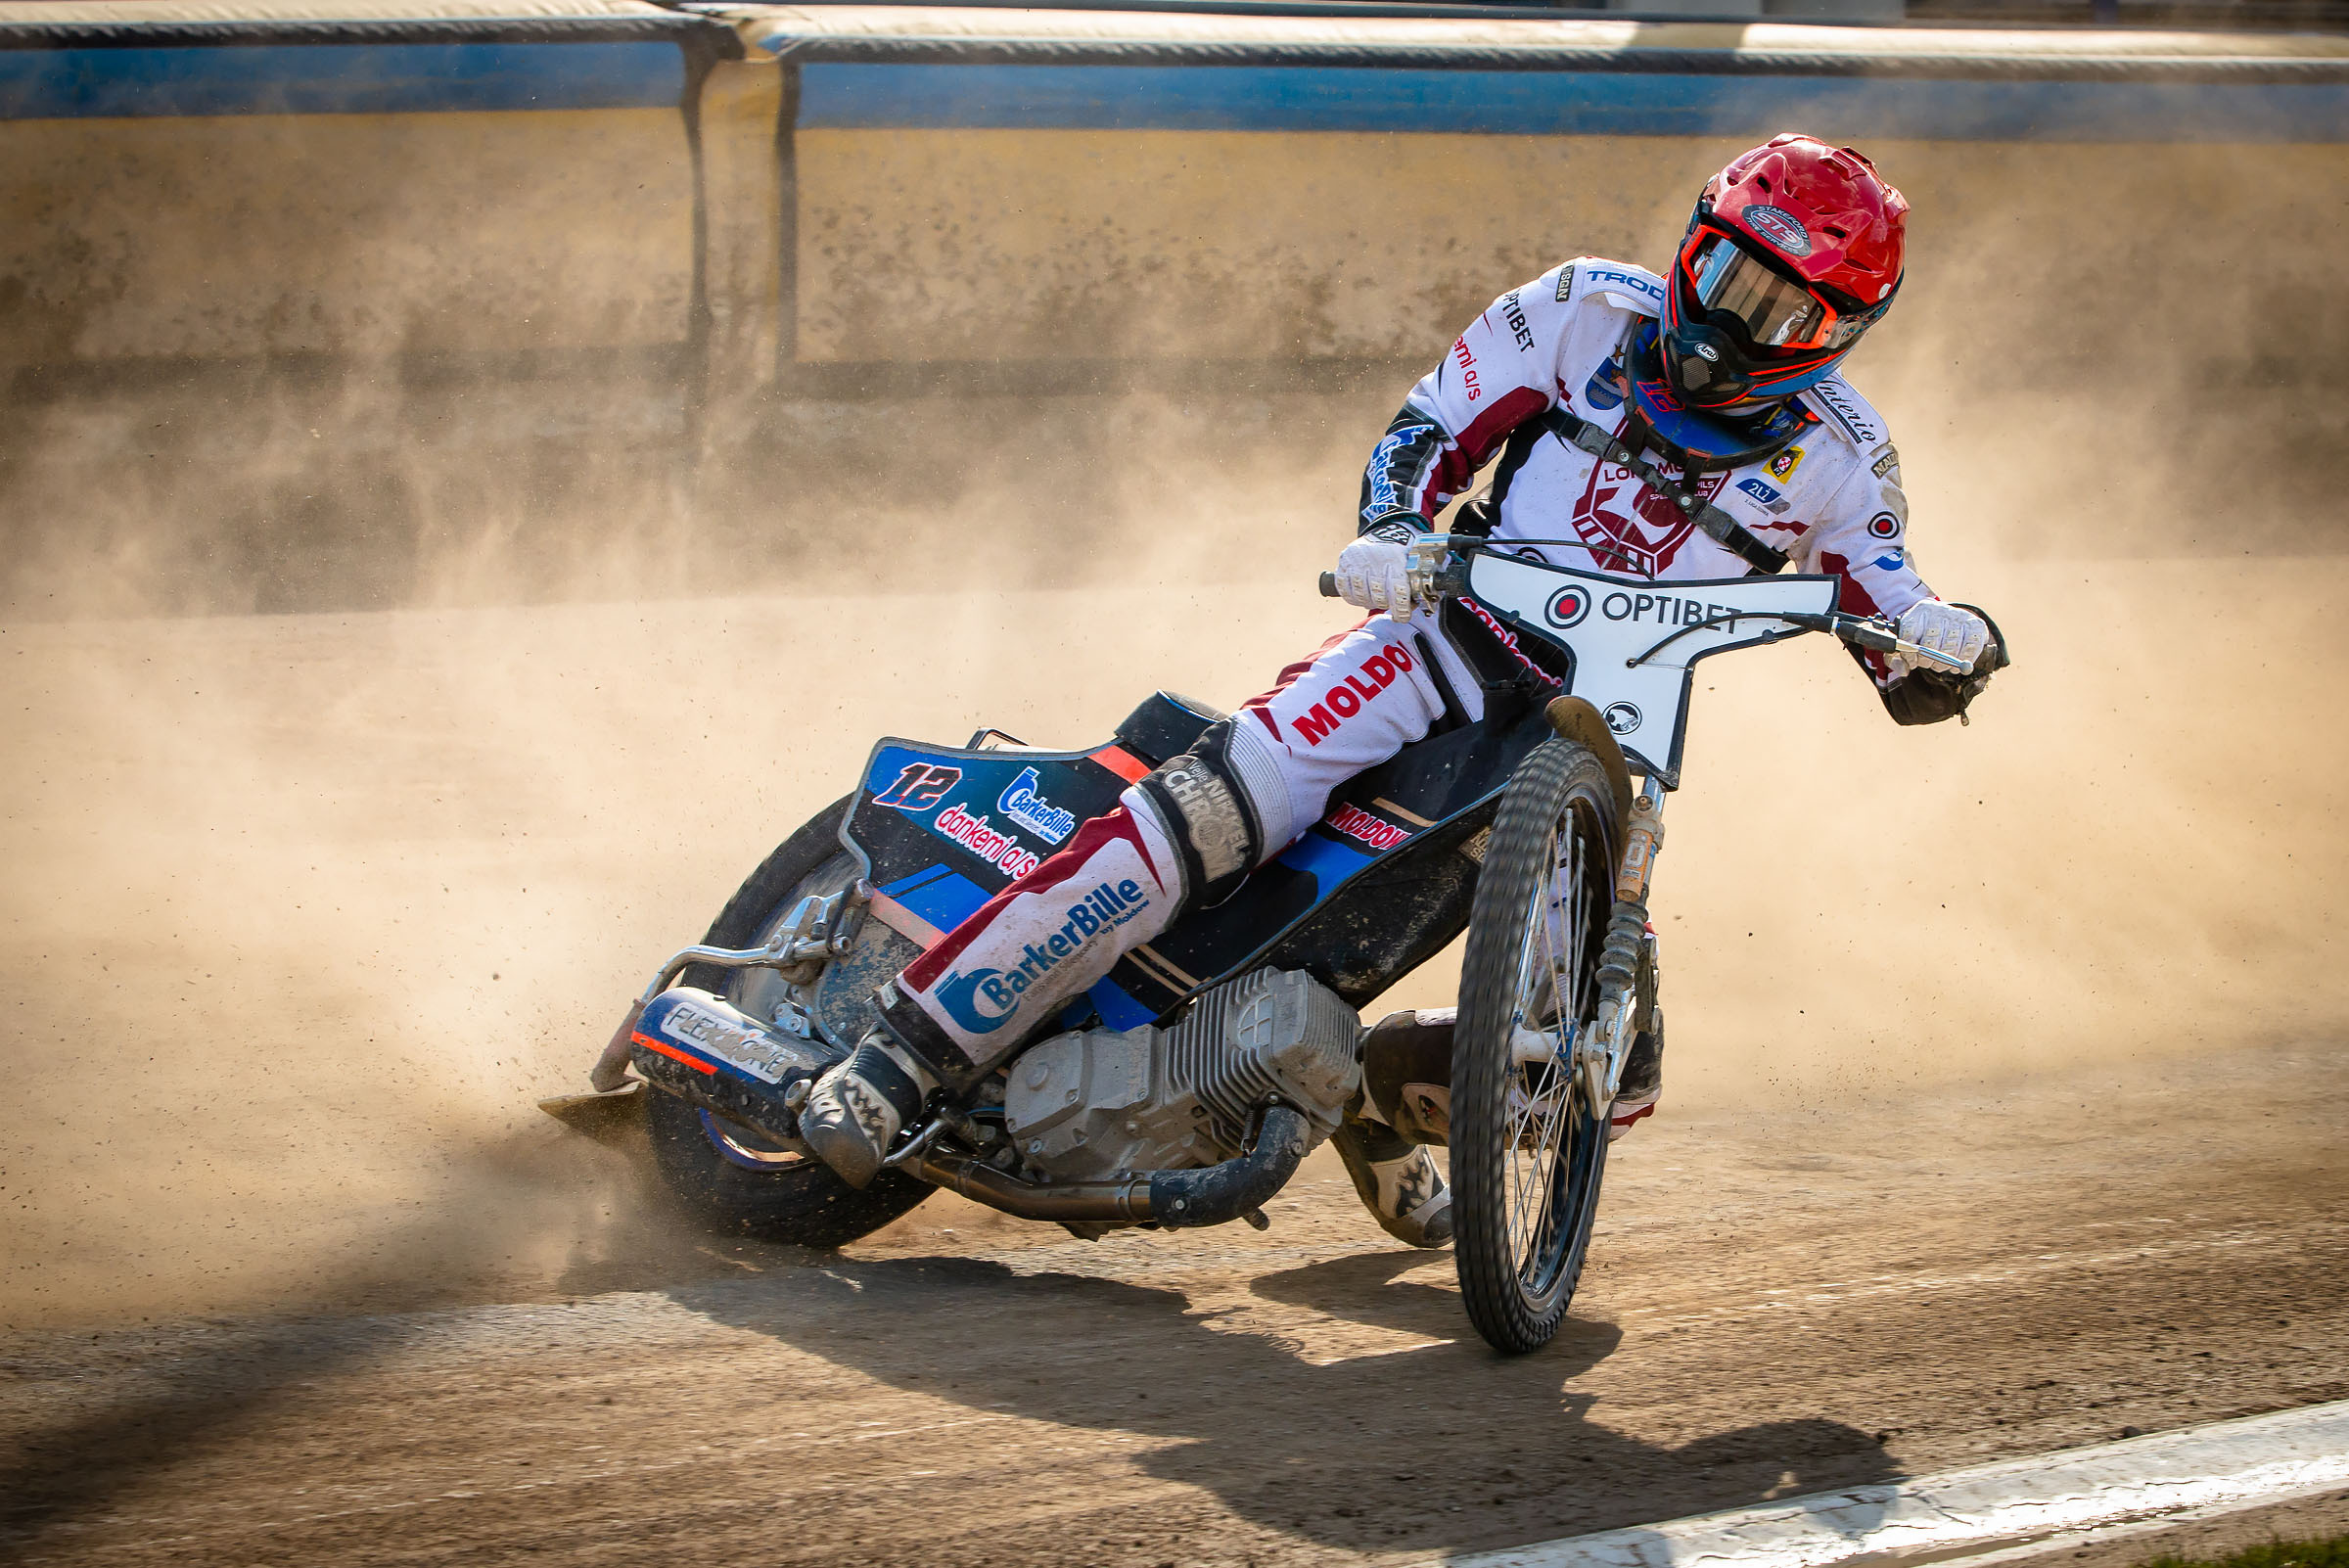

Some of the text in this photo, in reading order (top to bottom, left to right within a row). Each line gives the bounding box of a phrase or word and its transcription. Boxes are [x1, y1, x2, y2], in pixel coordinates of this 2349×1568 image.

[1752, 212, 1802, 244] STS
[1759, 206, 1809, 239] STAKEFORD
[1697, 344, 1717, 360] Arai
[1464, 370, 1481, 401] a/s
[1602, 591, 1742, 634] OPTIBET
[1291, 640, 1421, 747] MOLDO
[871, 761, 963, 811] 12
[1188, 761, 1209, 784] Vejle
[1011, 790, 1073, 837] BarkerBille
[935, 803, 1016, 863] dankemi
[1000, 848, 1038, 879] a/s
[981, 879, 1144, 1010] BarkerBille
